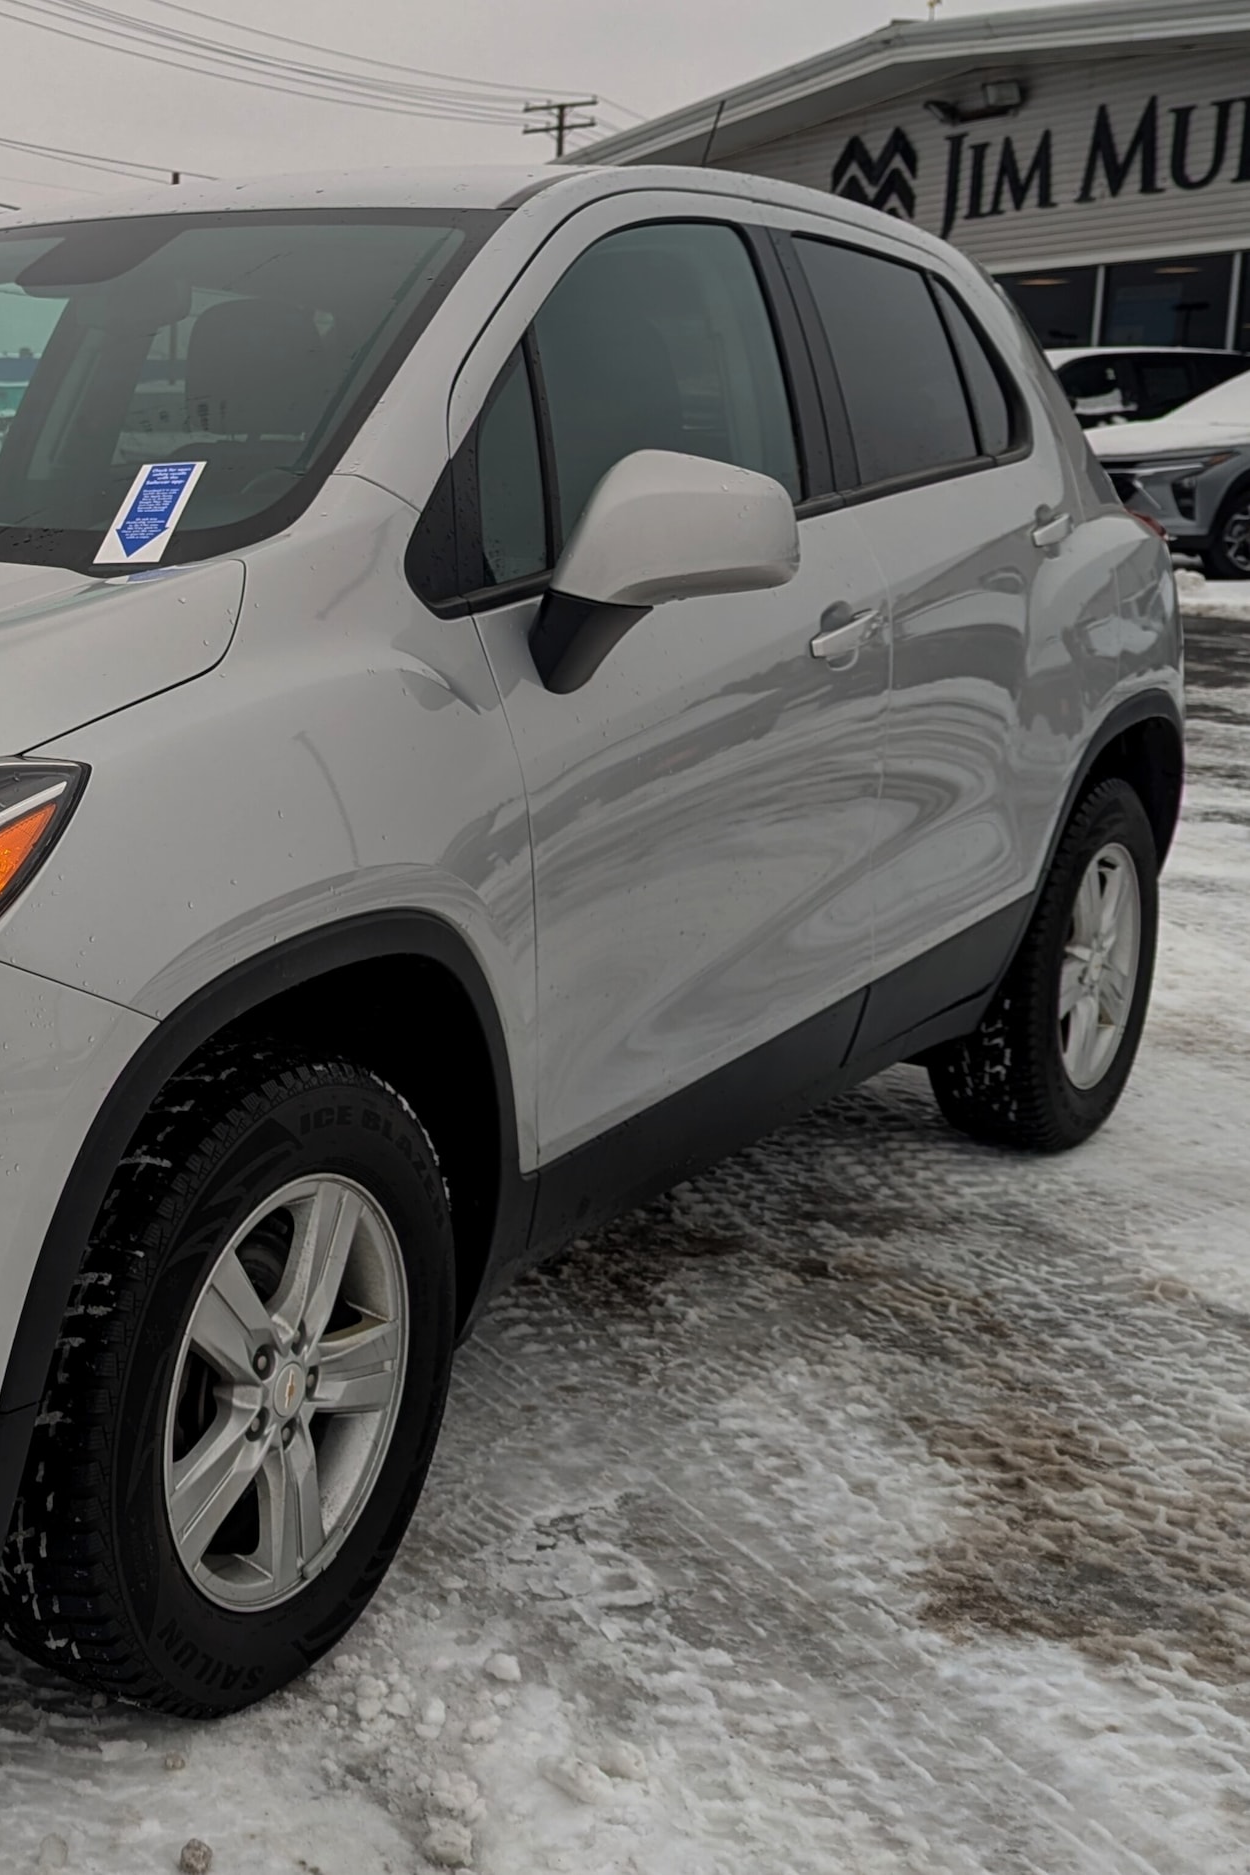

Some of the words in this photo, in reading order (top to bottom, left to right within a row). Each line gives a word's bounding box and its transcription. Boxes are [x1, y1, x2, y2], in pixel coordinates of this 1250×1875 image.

[940, 129, 1058, 241] JIM
[300, 1105, 353, 1136] ICE
[361, 1108, 444, 1229] BLAZER
[156, 1617, 265, 1690] SAILUN
